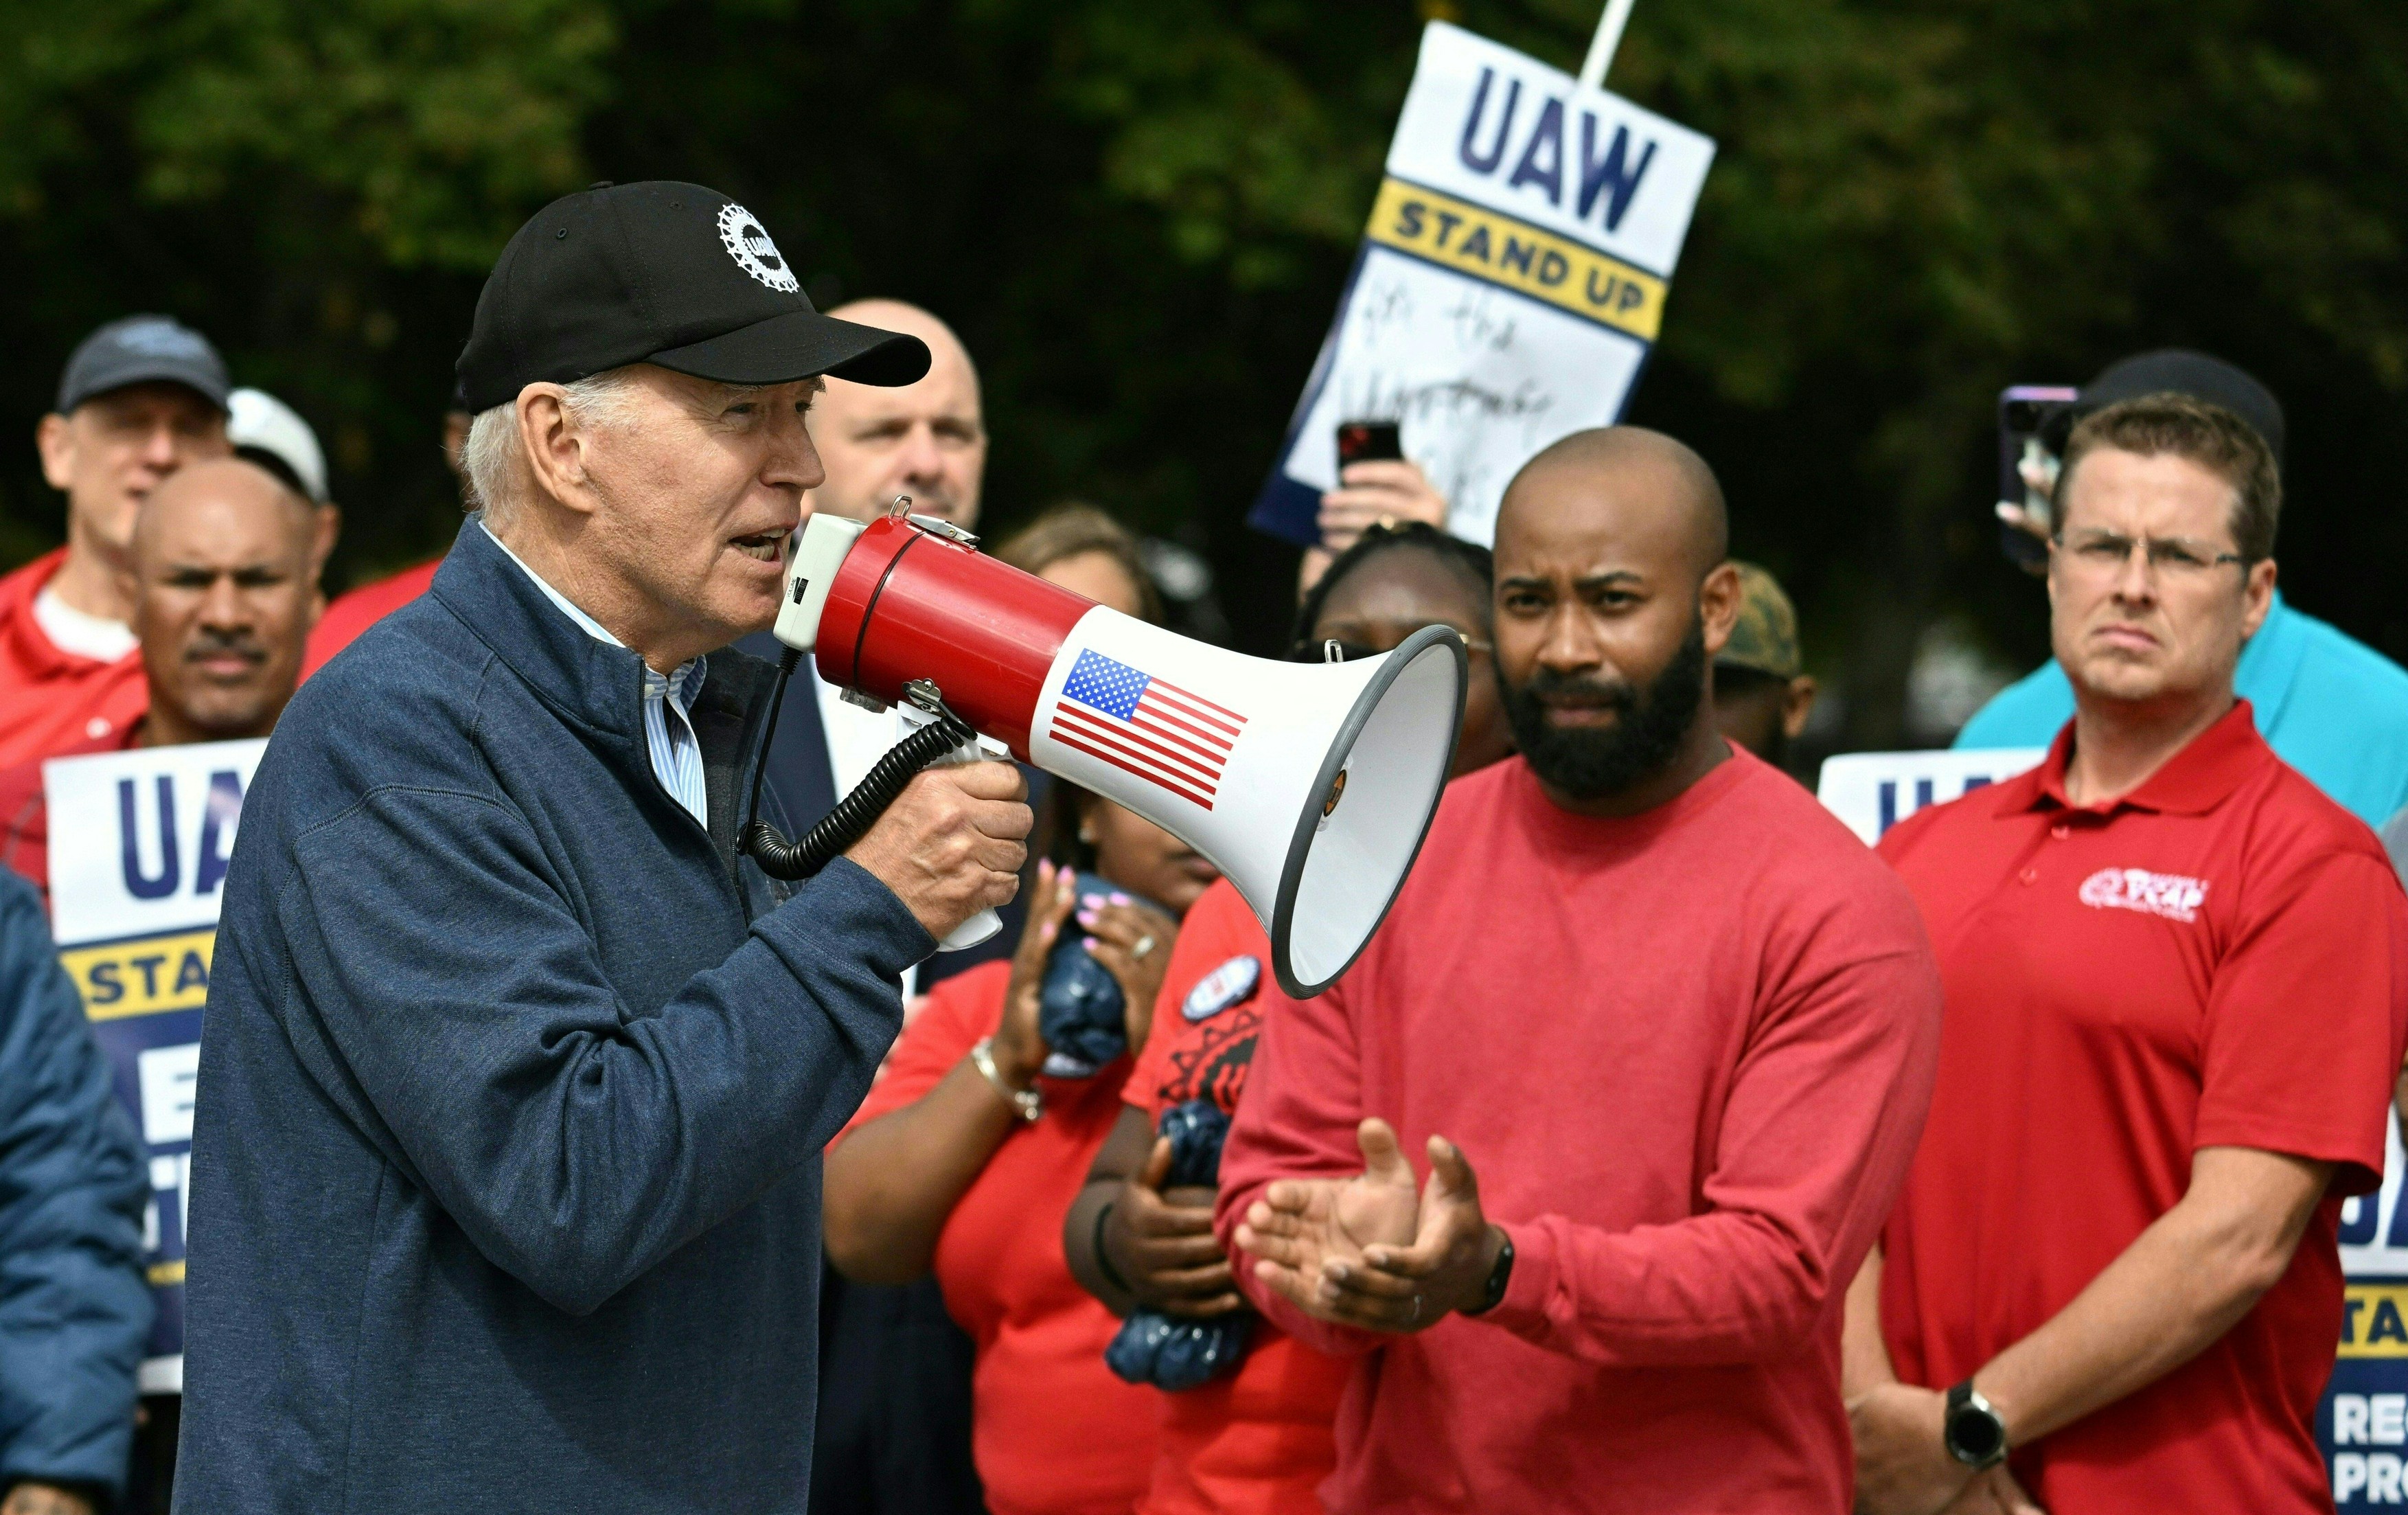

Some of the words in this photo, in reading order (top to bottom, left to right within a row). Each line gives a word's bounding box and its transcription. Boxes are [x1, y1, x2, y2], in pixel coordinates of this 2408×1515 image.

[1458, 66, 1658, 232] UAW
[744, 236, 777, 257] UAW
[1395, 201, 1569, 287] STAND
[1585, 267, 1644, 314] UP
[787, 578, 796, 597] VOLUME
[118, 769, 245, 900] UA
[89, 950, 209, 1005] STA
[2335, 1395, 2408, 1445] RE
[2335, 1453, 2408, 1504] PR
